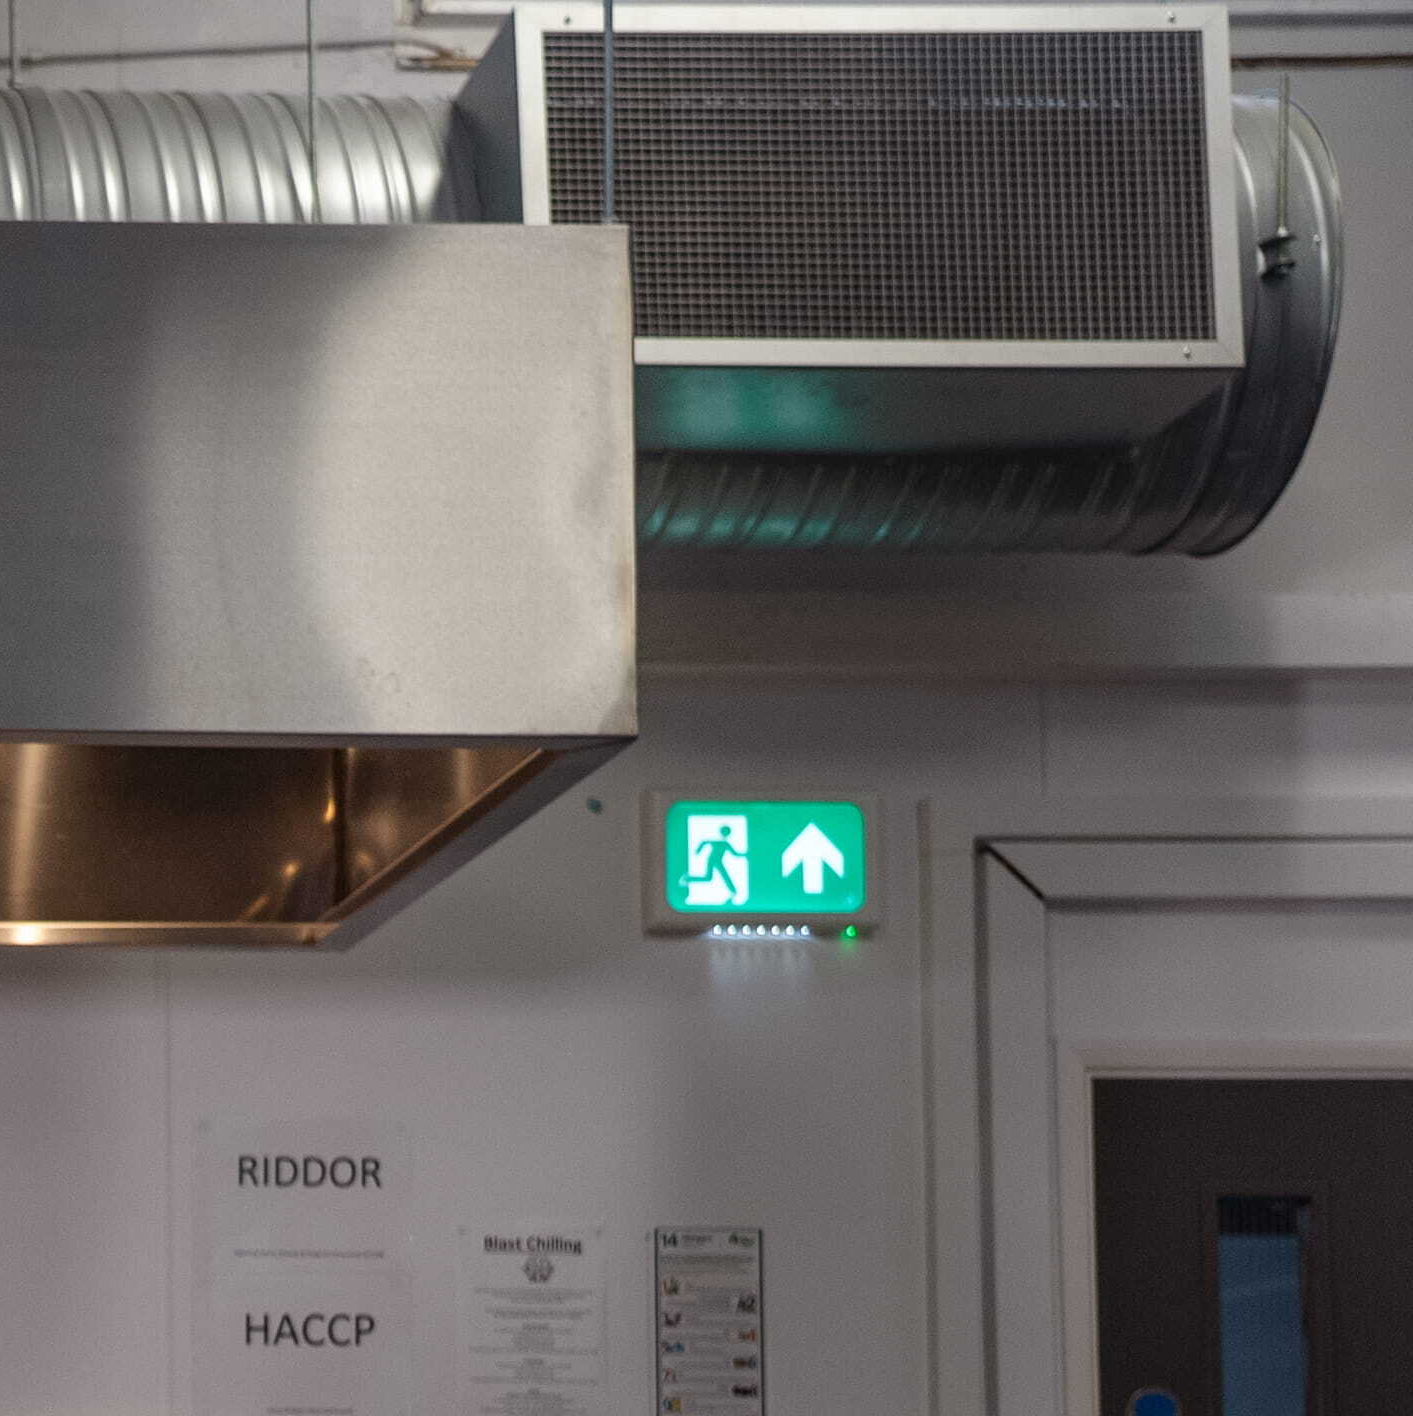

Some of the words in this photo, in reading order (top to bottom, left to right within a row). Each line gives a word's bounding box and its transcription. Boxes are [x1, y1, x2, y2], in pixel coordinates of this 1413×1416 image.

[237, 1155, 383, 1188] RIDDOR
[525, 1235, 582, 1255] Chilling
[245, 1313, 375, 1347] HACCP
